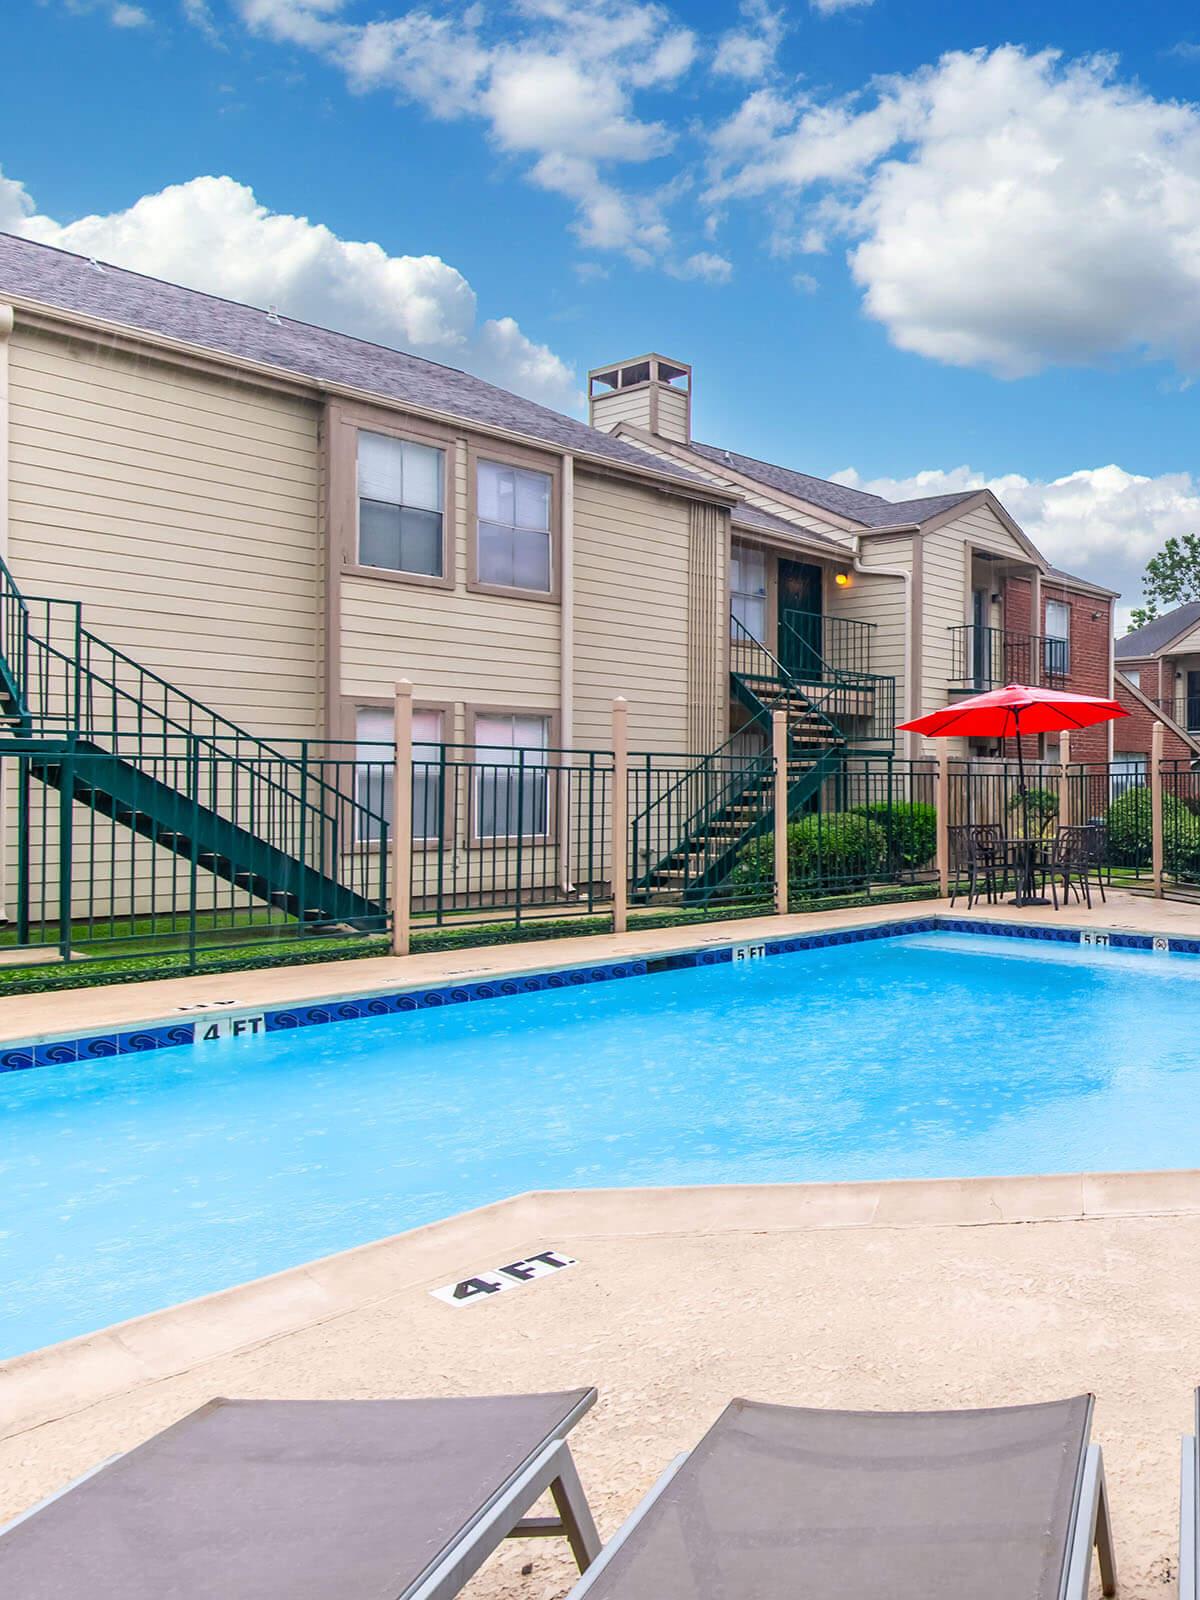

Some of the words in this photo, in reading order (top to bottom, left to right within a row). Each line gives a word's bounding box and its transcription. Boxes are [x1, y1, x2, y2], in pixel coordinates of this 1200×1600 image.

[1084, 934, 1091, 945] 5
[1095, 935, 1109, 946] FT
[737, 948, 745, 961] 5
[750, 946, 765, 959] FT
[203, 1023, 220, 1041] 4
[233, 1017, 263, 1036] FT
[452, 1277, 503, 1300] 4
